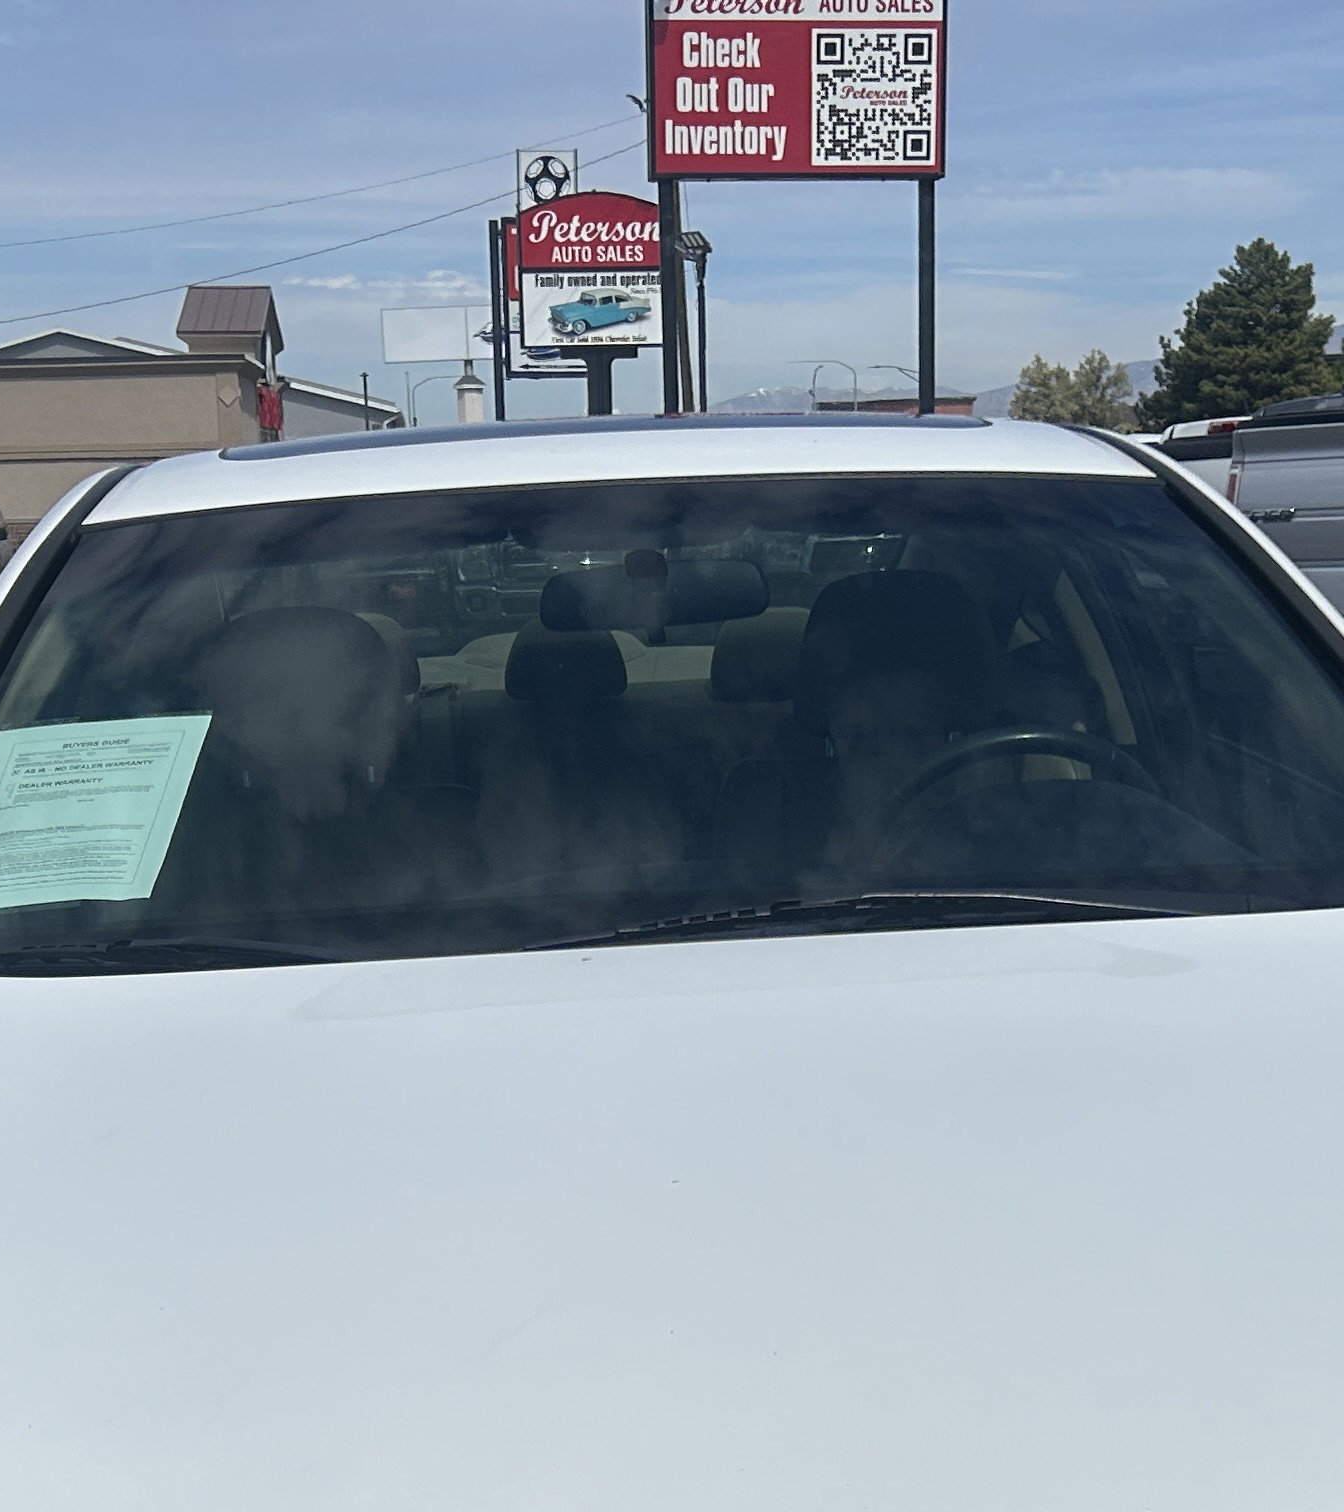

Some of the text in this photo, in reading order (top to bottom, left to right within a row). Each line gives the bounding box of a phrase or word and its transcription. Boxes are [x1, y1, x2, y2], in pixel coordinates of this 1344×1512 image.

[682, 31, 761, 69] Check
[675, 77, 775, 114] Out Our
[840, 84, 909, 100] Peterson
[663, 119, 788, 161] Inventory
[528, 209, 660, 243] Peterson
[551, 245, 644, 263] AUTO SALES
[600, 274, 616, 287] and
[105, 759, 154, 769] WARRANTY
